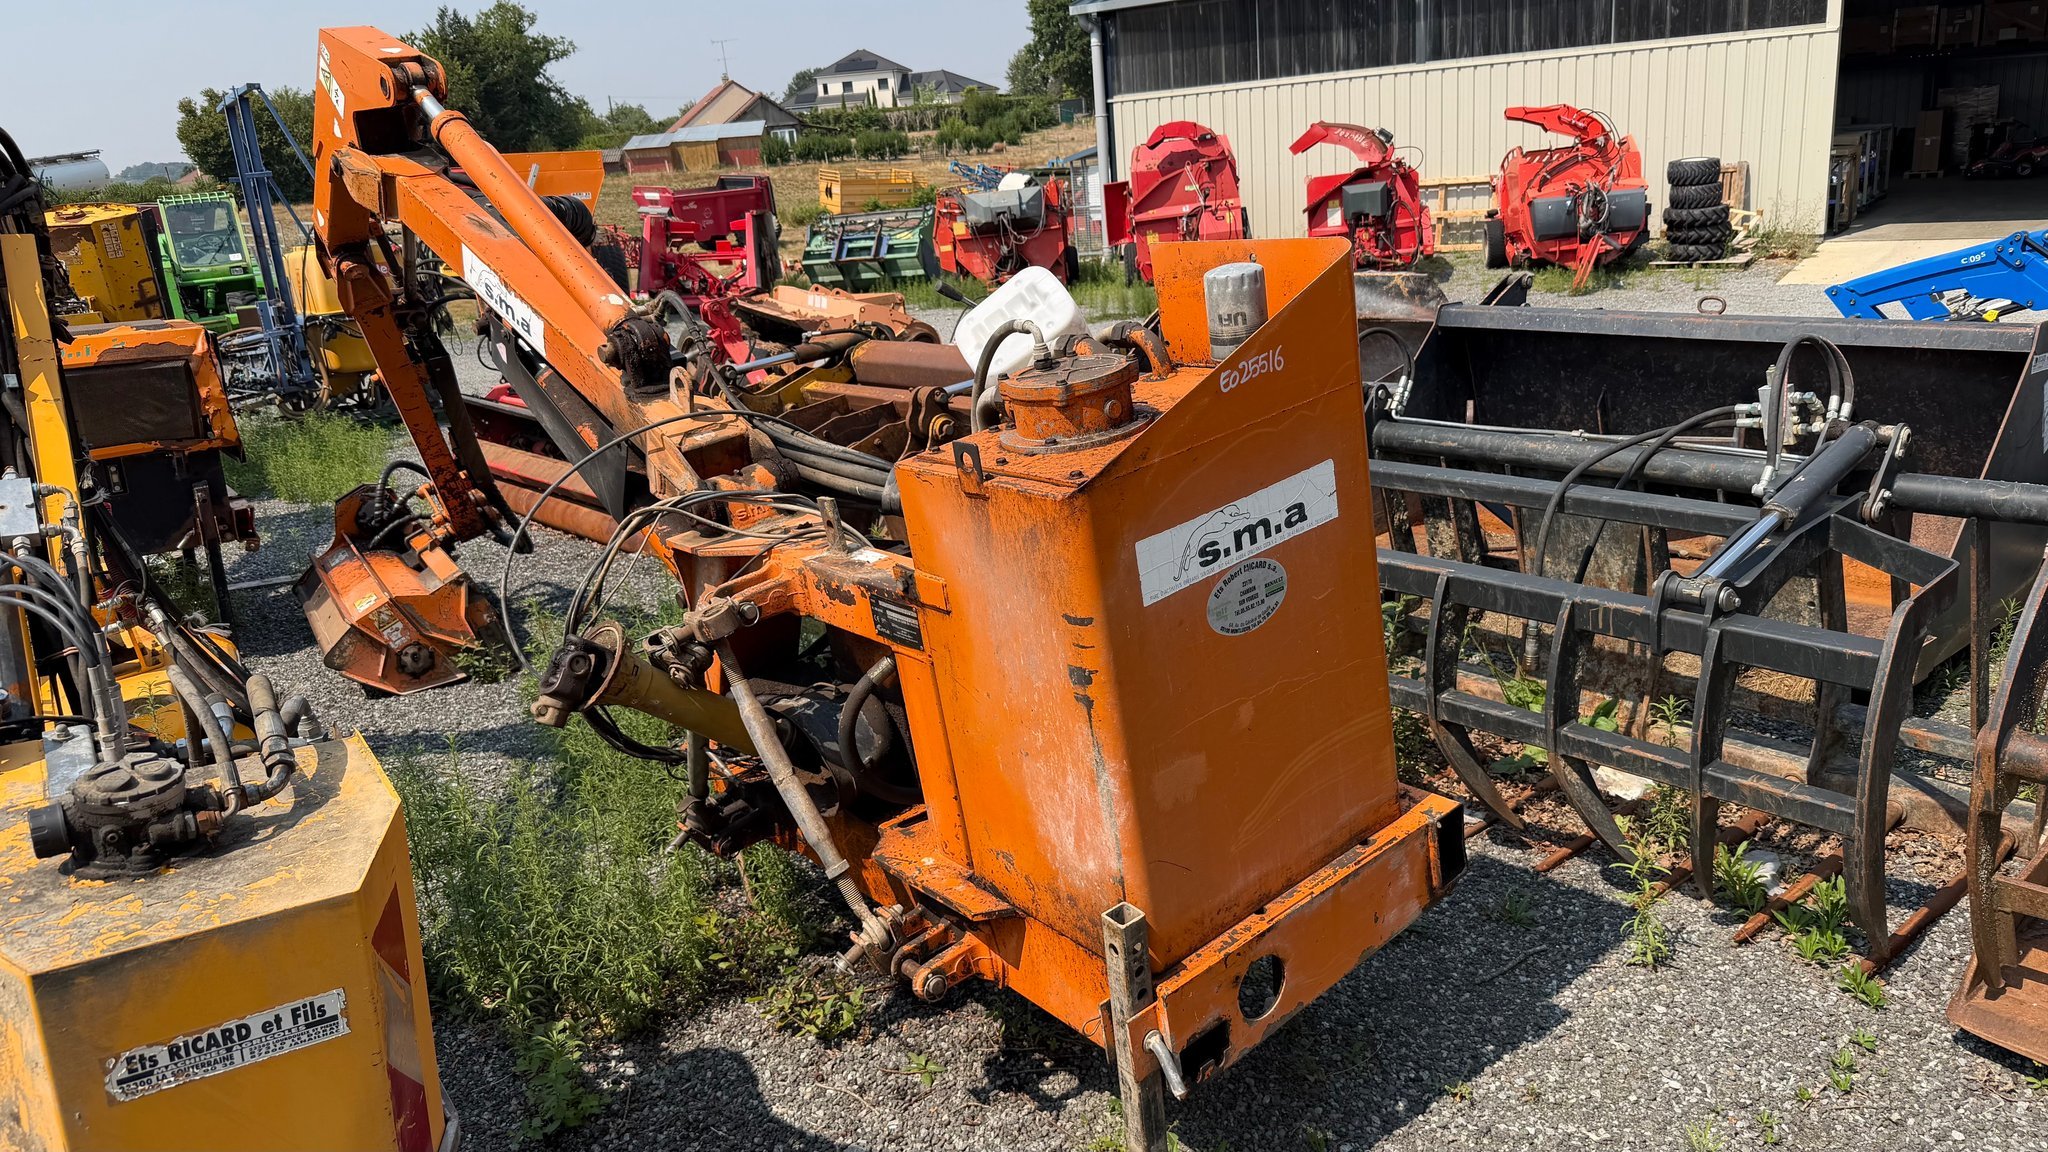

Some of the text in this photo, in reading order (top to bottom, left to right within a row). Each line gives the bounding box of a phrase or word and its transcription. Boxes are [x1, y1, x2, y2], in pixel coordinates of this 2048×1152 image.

[484, 282, 533, 338] s.m.a
[1217, 311, 1248, 328] UFI
[1198, 501, 1308, 568] s.m.a
[1214, 587, 1224, 599] Ets
[1222, 567, 1243, 587] Robert
[1264, 576, 1283, 588] RENAULT
[126, 1001, 327, 1074] Ets RICARD et Fils
[289, 1028, 340, 1047] JANAILHAC
[307, 1025, 340, 1038] DORAT
[153, 1025, 307, 1074] MACHINES AGRICOLES
[156, 1073, 167, 1082] LA
[171, 1053, 235, 1077] SOUTERRAINE
